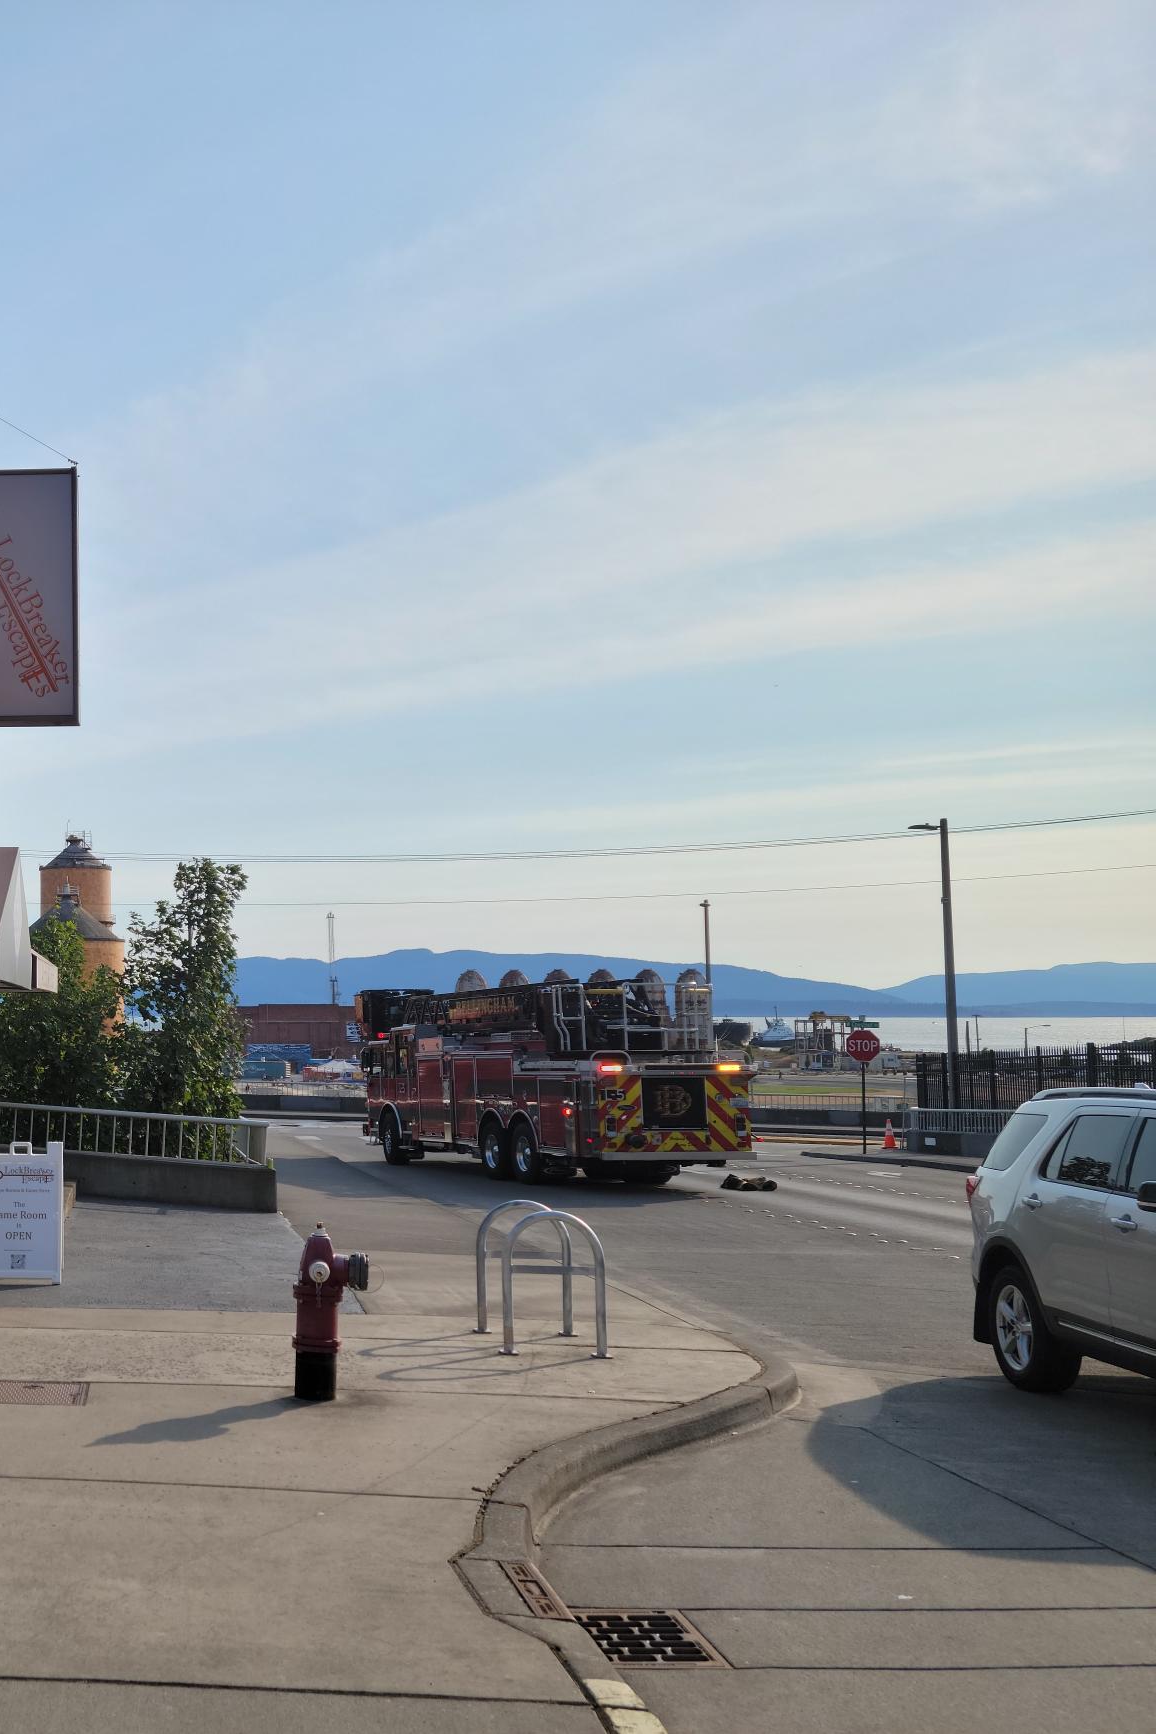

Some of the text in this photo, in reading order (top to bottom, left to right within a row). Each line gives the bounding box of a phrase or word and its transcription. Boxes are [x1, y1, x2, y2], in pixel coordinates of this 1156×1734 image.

[848, 1039, 878, 1052] STOP
[4, 1165, 54, 1175] LockBreaker
[20, 1210, 47, 1219] Room
[5, 1231, 33, 1240] OPEN
